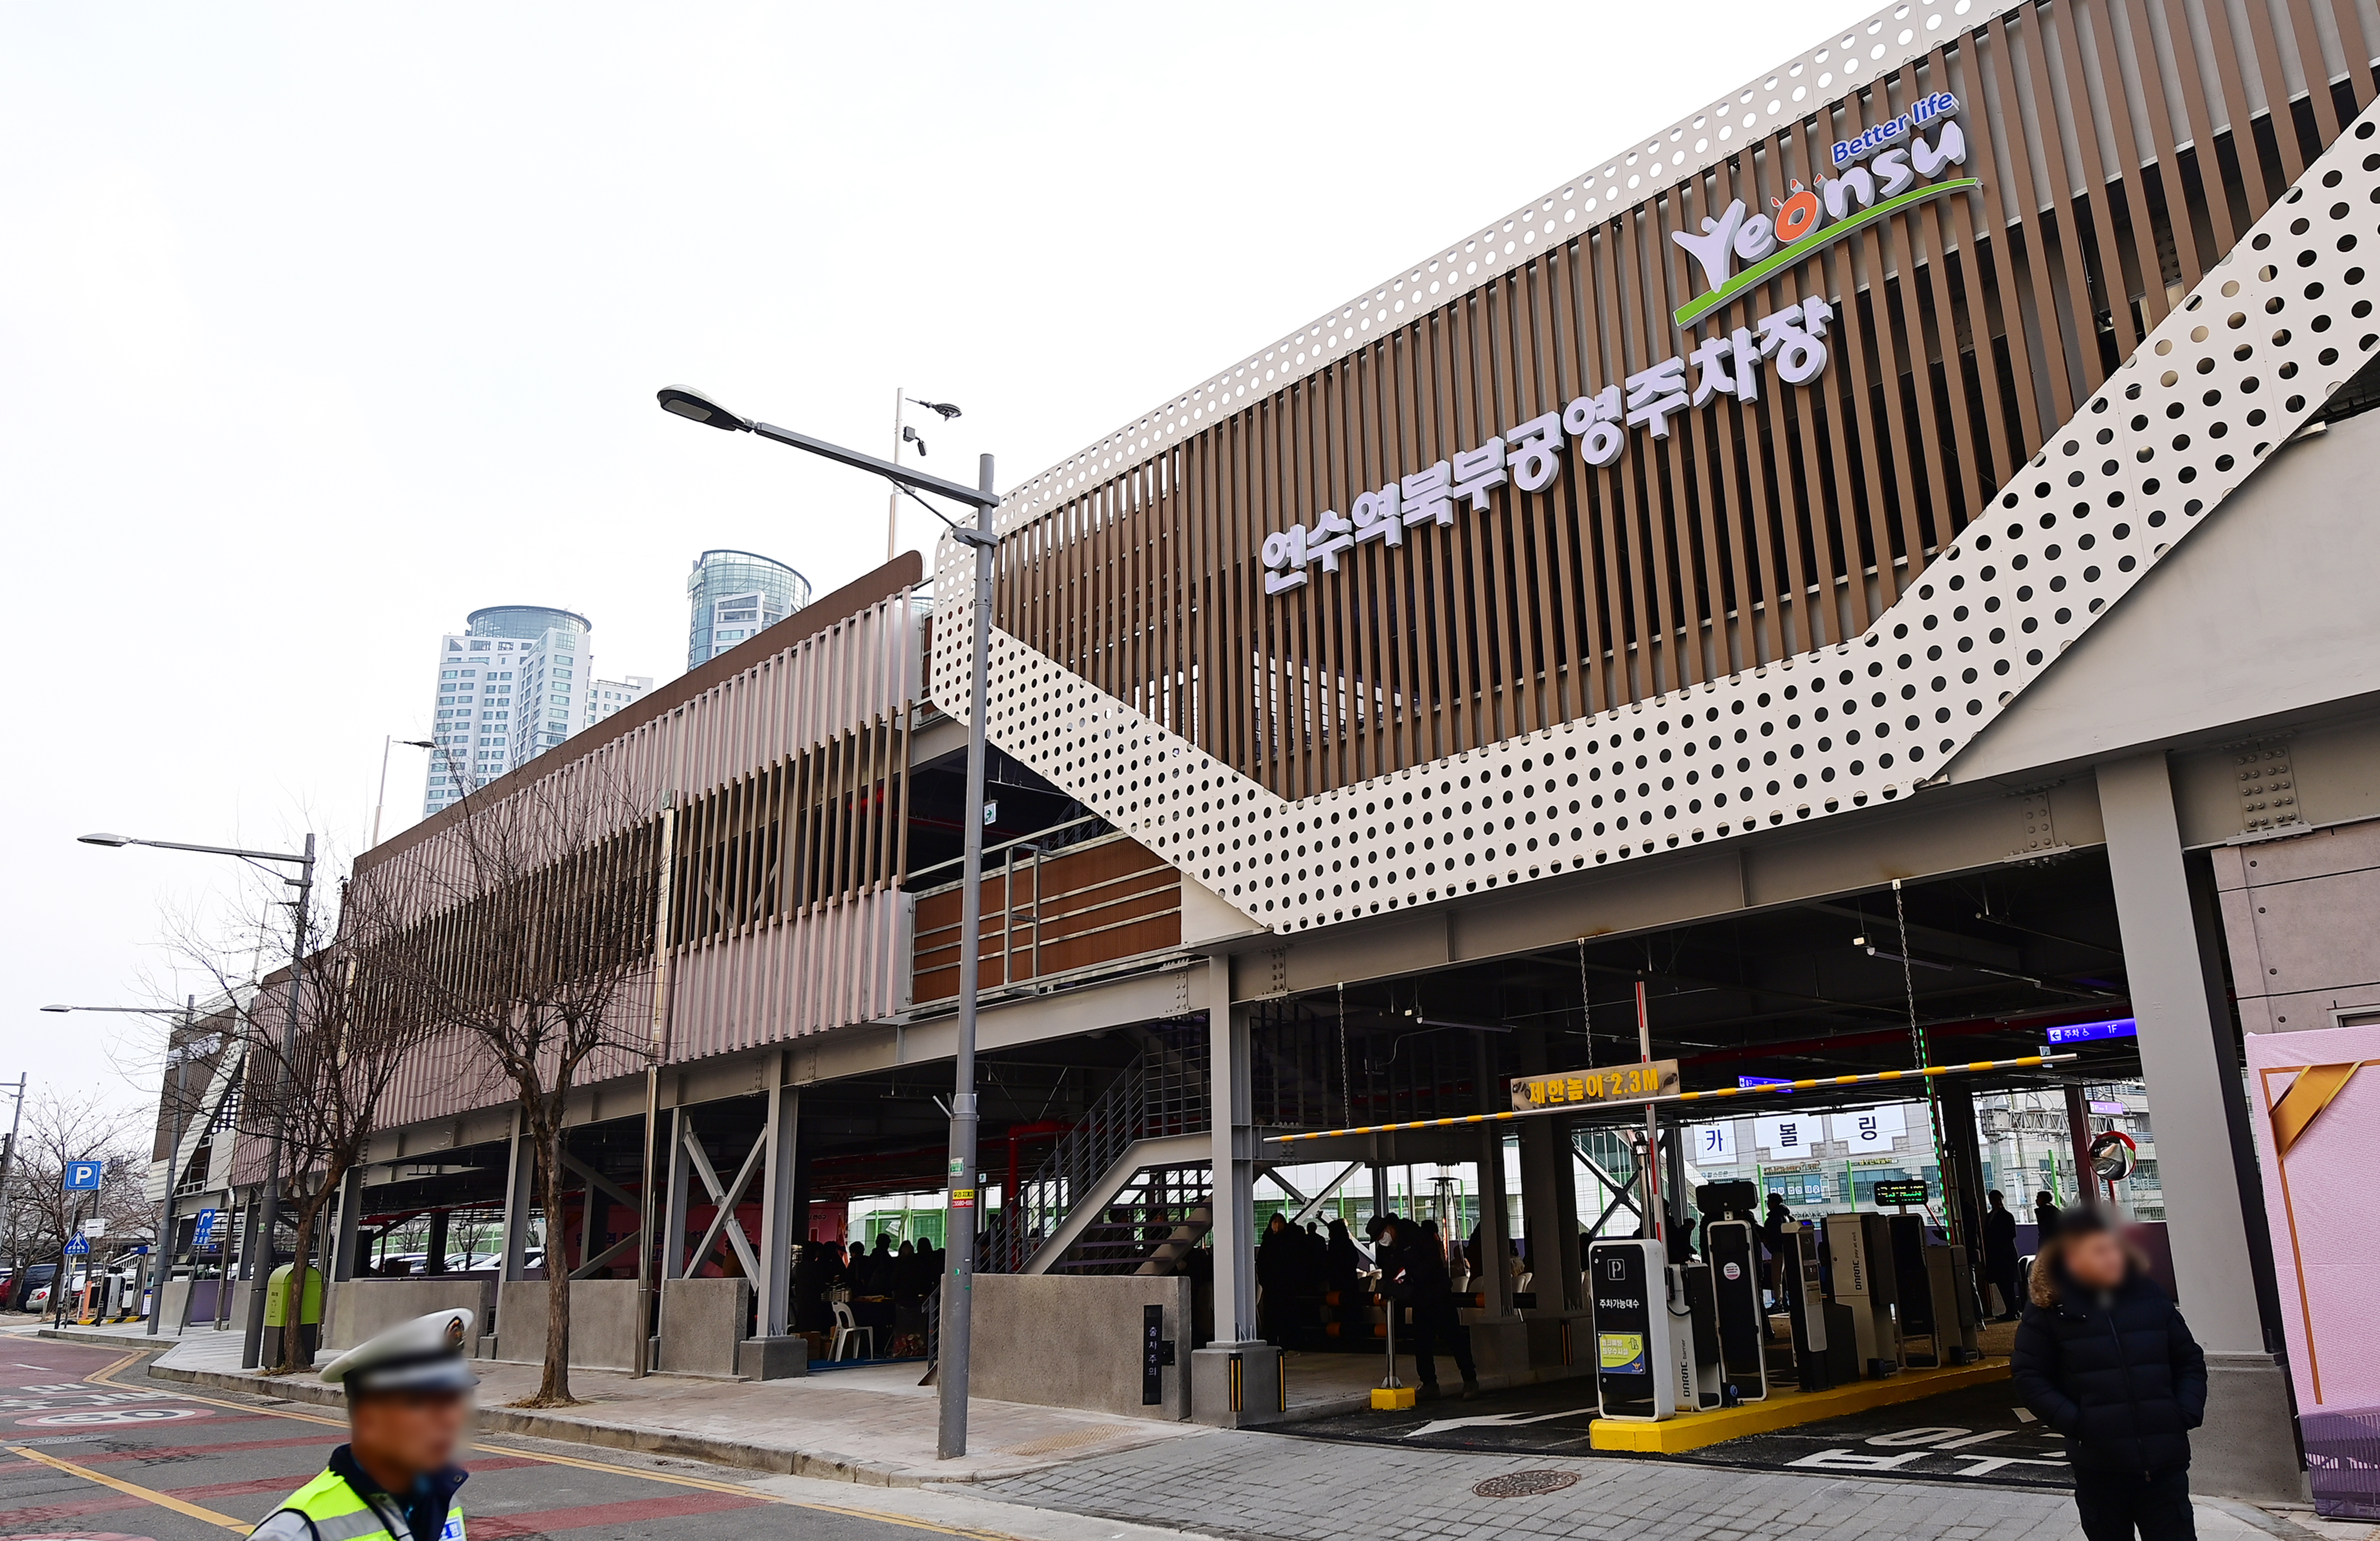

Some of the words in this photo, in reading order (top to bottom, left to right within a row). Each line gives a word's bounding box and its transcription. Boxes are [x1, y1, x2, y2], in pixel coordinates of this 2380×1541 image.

[1832, 113, 1907, 166] Better
[1911, 91, 1958, 127] life
[1671, 120, 1966, 293] Yeonsu
[1261, 294, 1833, 596] 연수역북부공영주차장
[2064, 1028, 2080, 1038] 주차
[2107, 1024, 2118, 1034] 1F
[1529, 1073, 1604, 1104] 제한높이
[1611, 1068, 1659, 1095] 2.3M
[75, 1166, 93, 1184] P
[1852, 1260, 1862, 1290] DARAE
[1599, 1299, 1640, 1309] 주차가능대수
[1148, 1326, 1157, 1376] 출차주의
[1680, 1361, 1690, 1398] DARAE
[48, 1410, 180, 1423] 30
